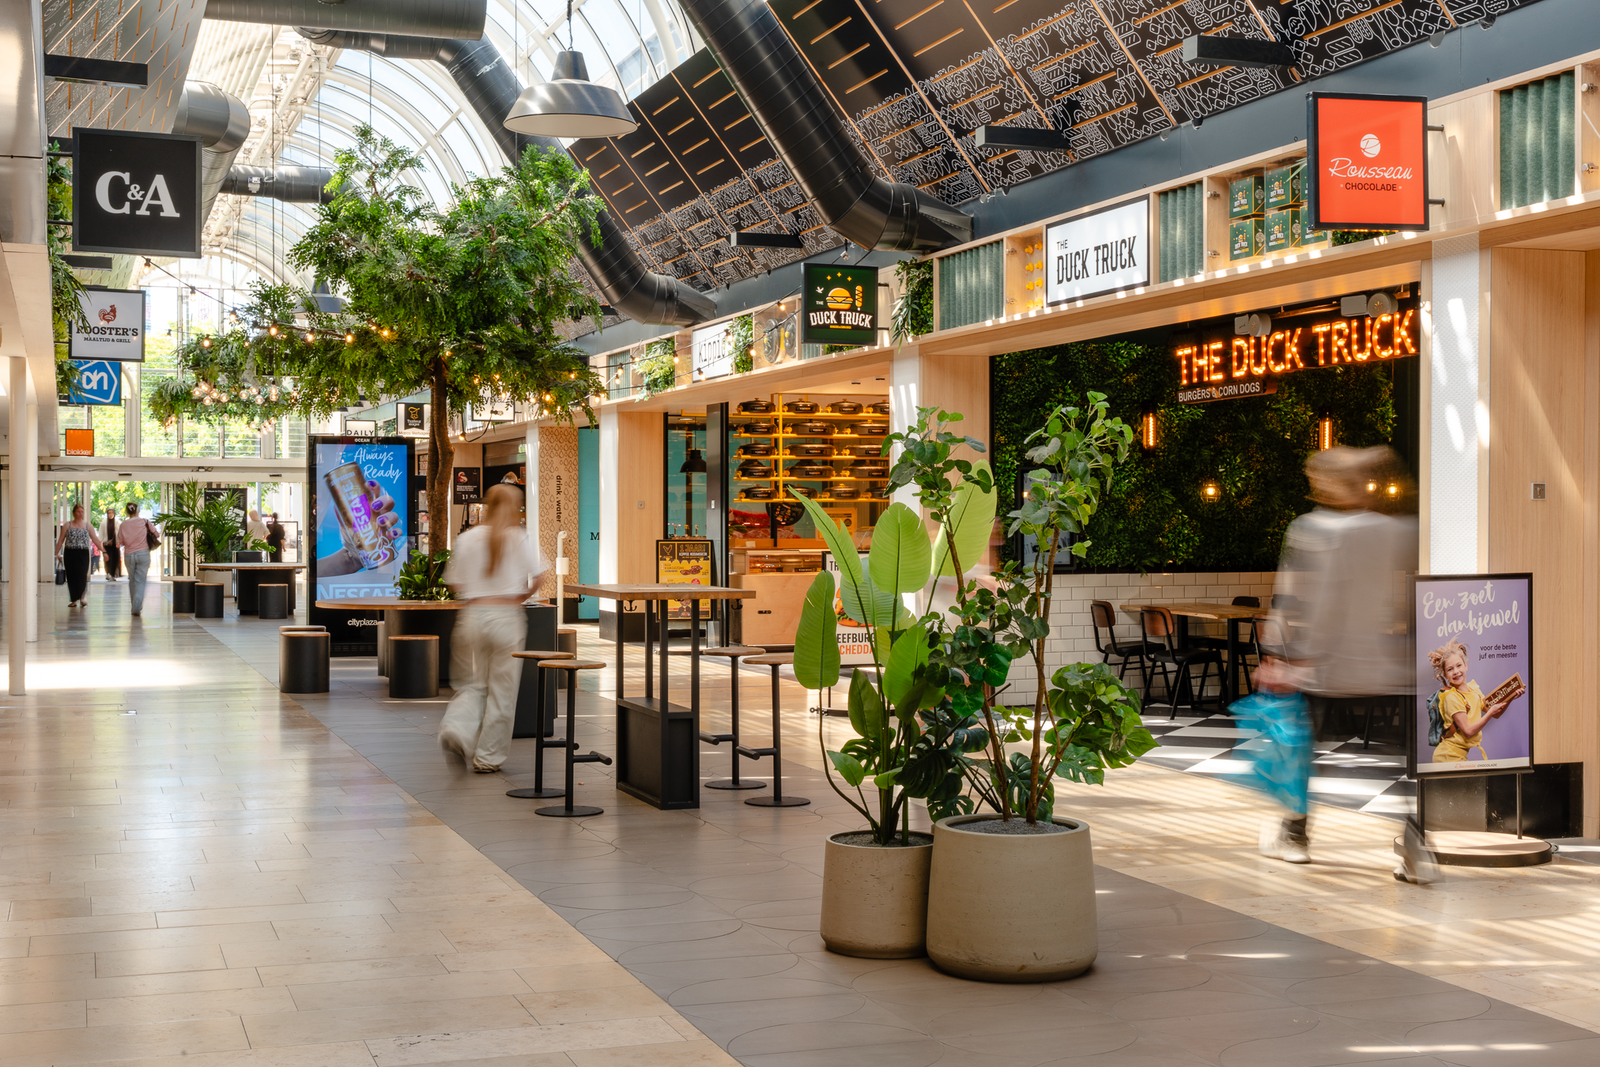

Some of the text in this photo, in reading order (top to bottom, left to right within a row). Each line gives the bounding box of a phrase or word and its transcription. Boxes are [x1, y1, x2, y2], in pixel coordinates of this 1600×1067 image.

[1328, 157, 1414, 179] Rousseau
[95, 171, 181, 218] C&A
[1344, 182, 1398, 191] CHOCOLADE
[1056, 238, 1068, 250] THE
[1056, 235, 1137, 285] DUCK TRUCK
[808, 310, 838, 326] DUCK
[839, 311, 873, 329] TRUCK
[76, 326, 139, 337] ROOSTER'S
[1176, 309, 1417, 386] THE DUCK TRUCK
[1178, 381, 1261, 403] BURGERS & CORN DOGS
[346, 429, 375, 437] DAILY
[353, 447, 394, 467] Always
[363, 463, 403, 484] Ready
[555, 474, 563, 496] drink
[316, 583, 404, 602] NESCAF
[1422, 581, 1496, 619] Een zoet
[347, 618, 378, 628] cityplaza
[1436, 600, 1521, 638] dankjewel
[836, 632, 875, 644] EEFBURG
[839, 644, 873, 655] CHEDD
[1478, 653, 1487, 661] juf
[1496, 651, 1518, 659] meester
